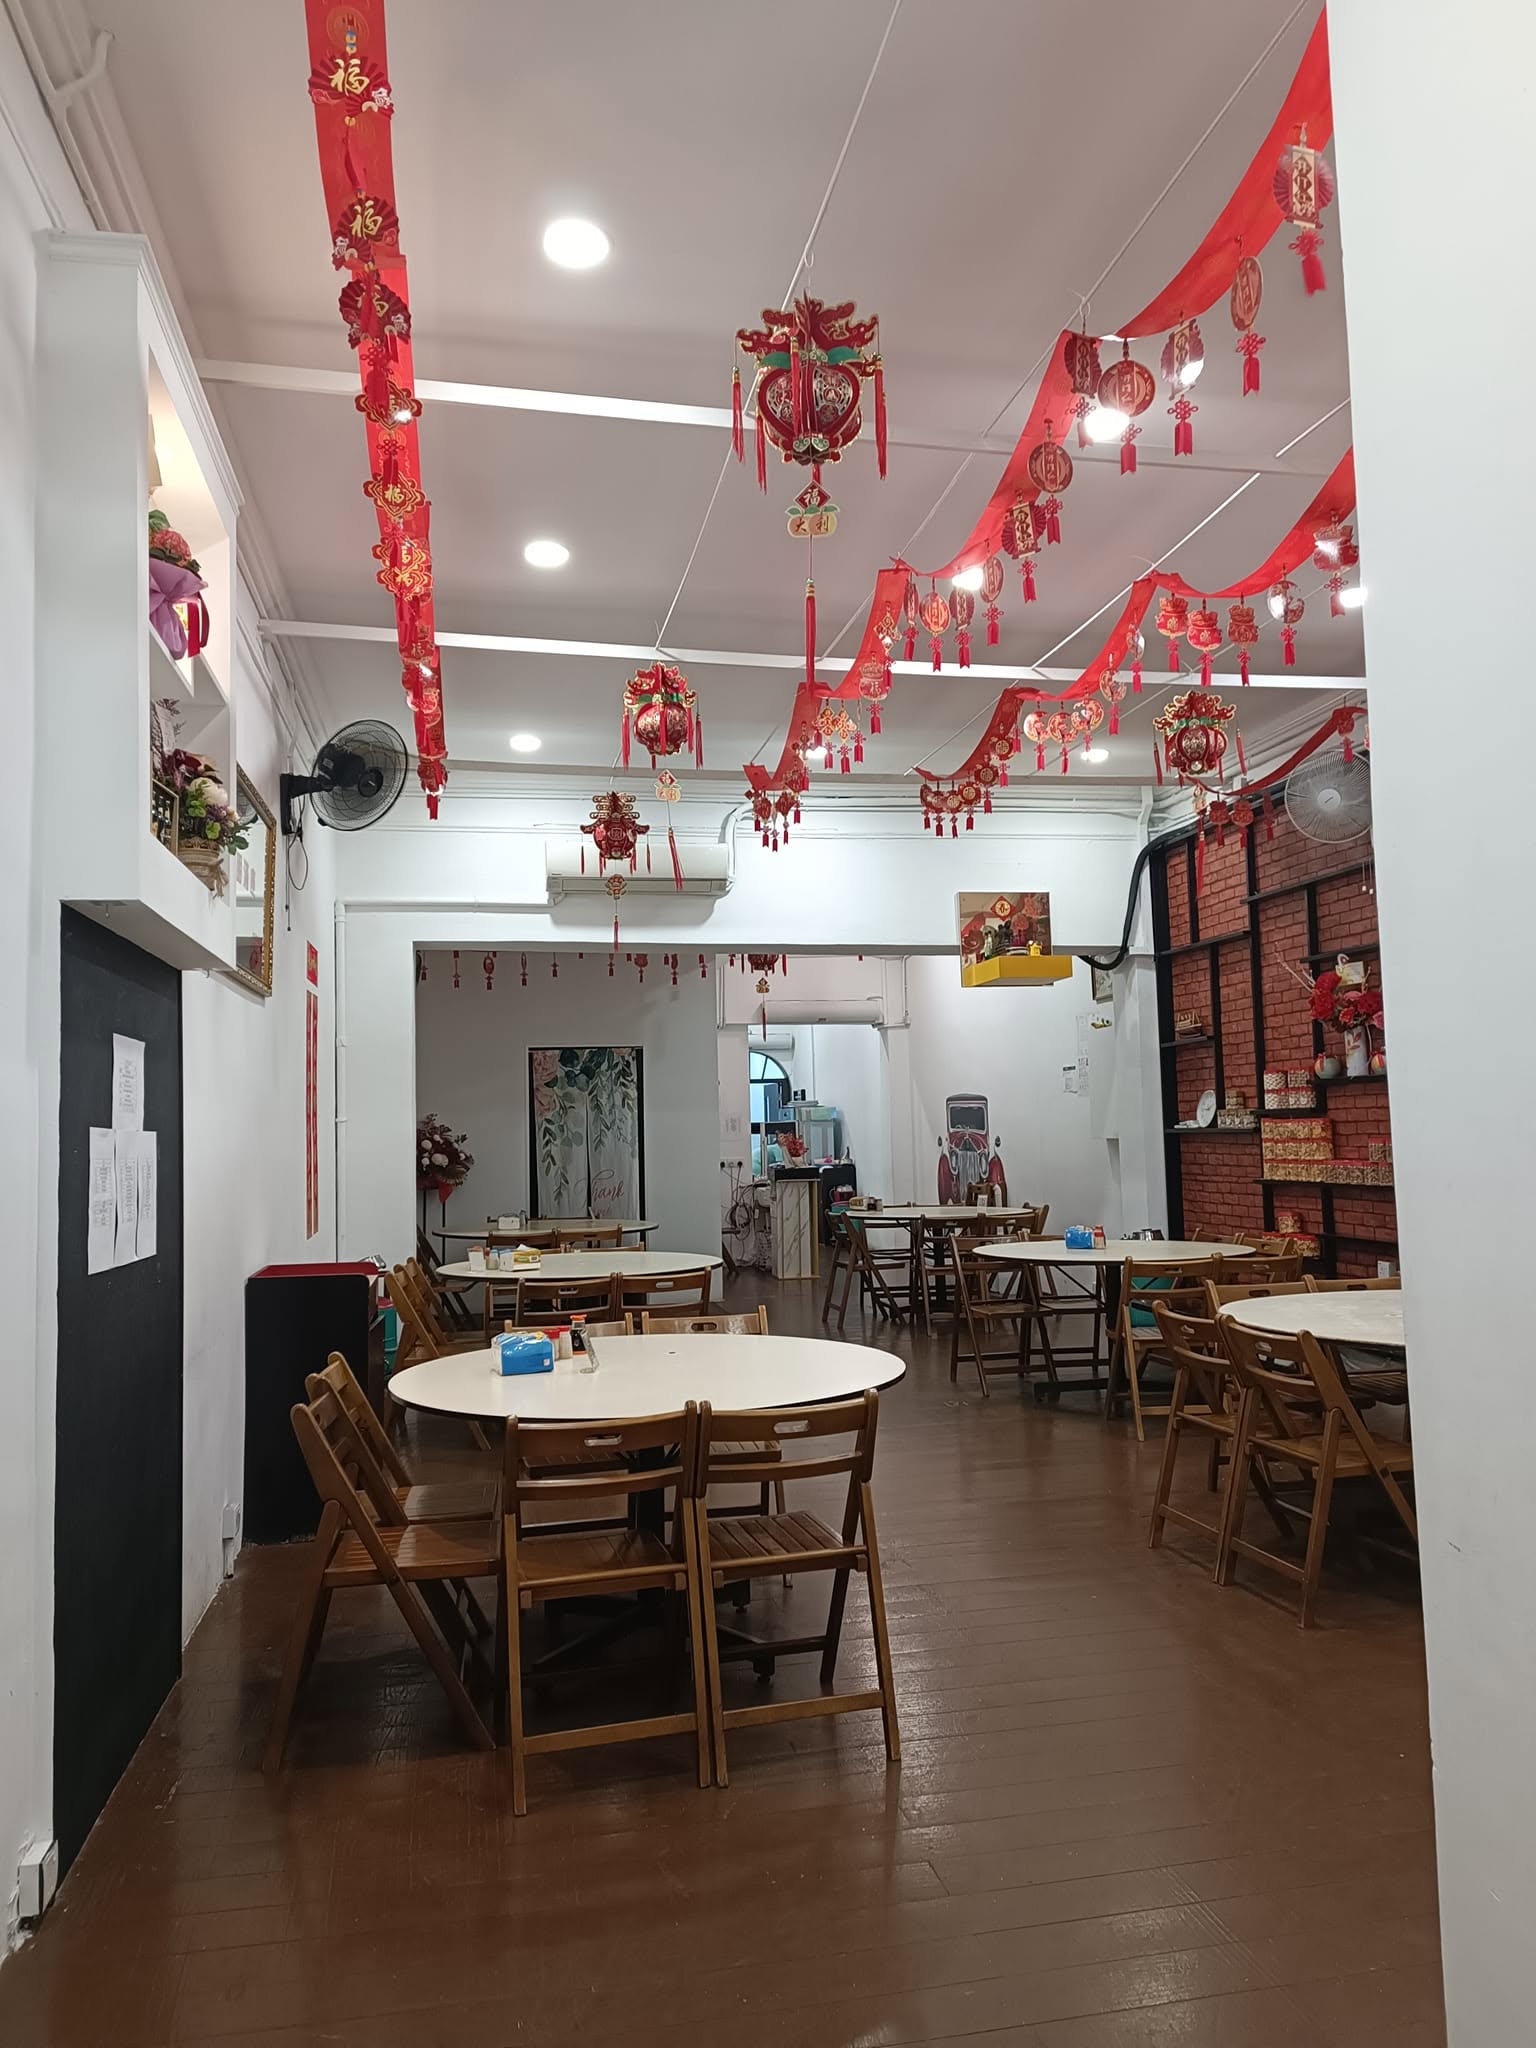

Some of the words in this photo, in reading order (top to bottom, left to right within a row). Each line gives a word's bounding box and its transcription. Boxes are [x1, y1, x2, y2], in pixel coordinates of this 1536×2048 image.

[329, 57, 371, 97] 福
[350, 199, 384, 239] 福
[803, 487, 821, 507] 福
